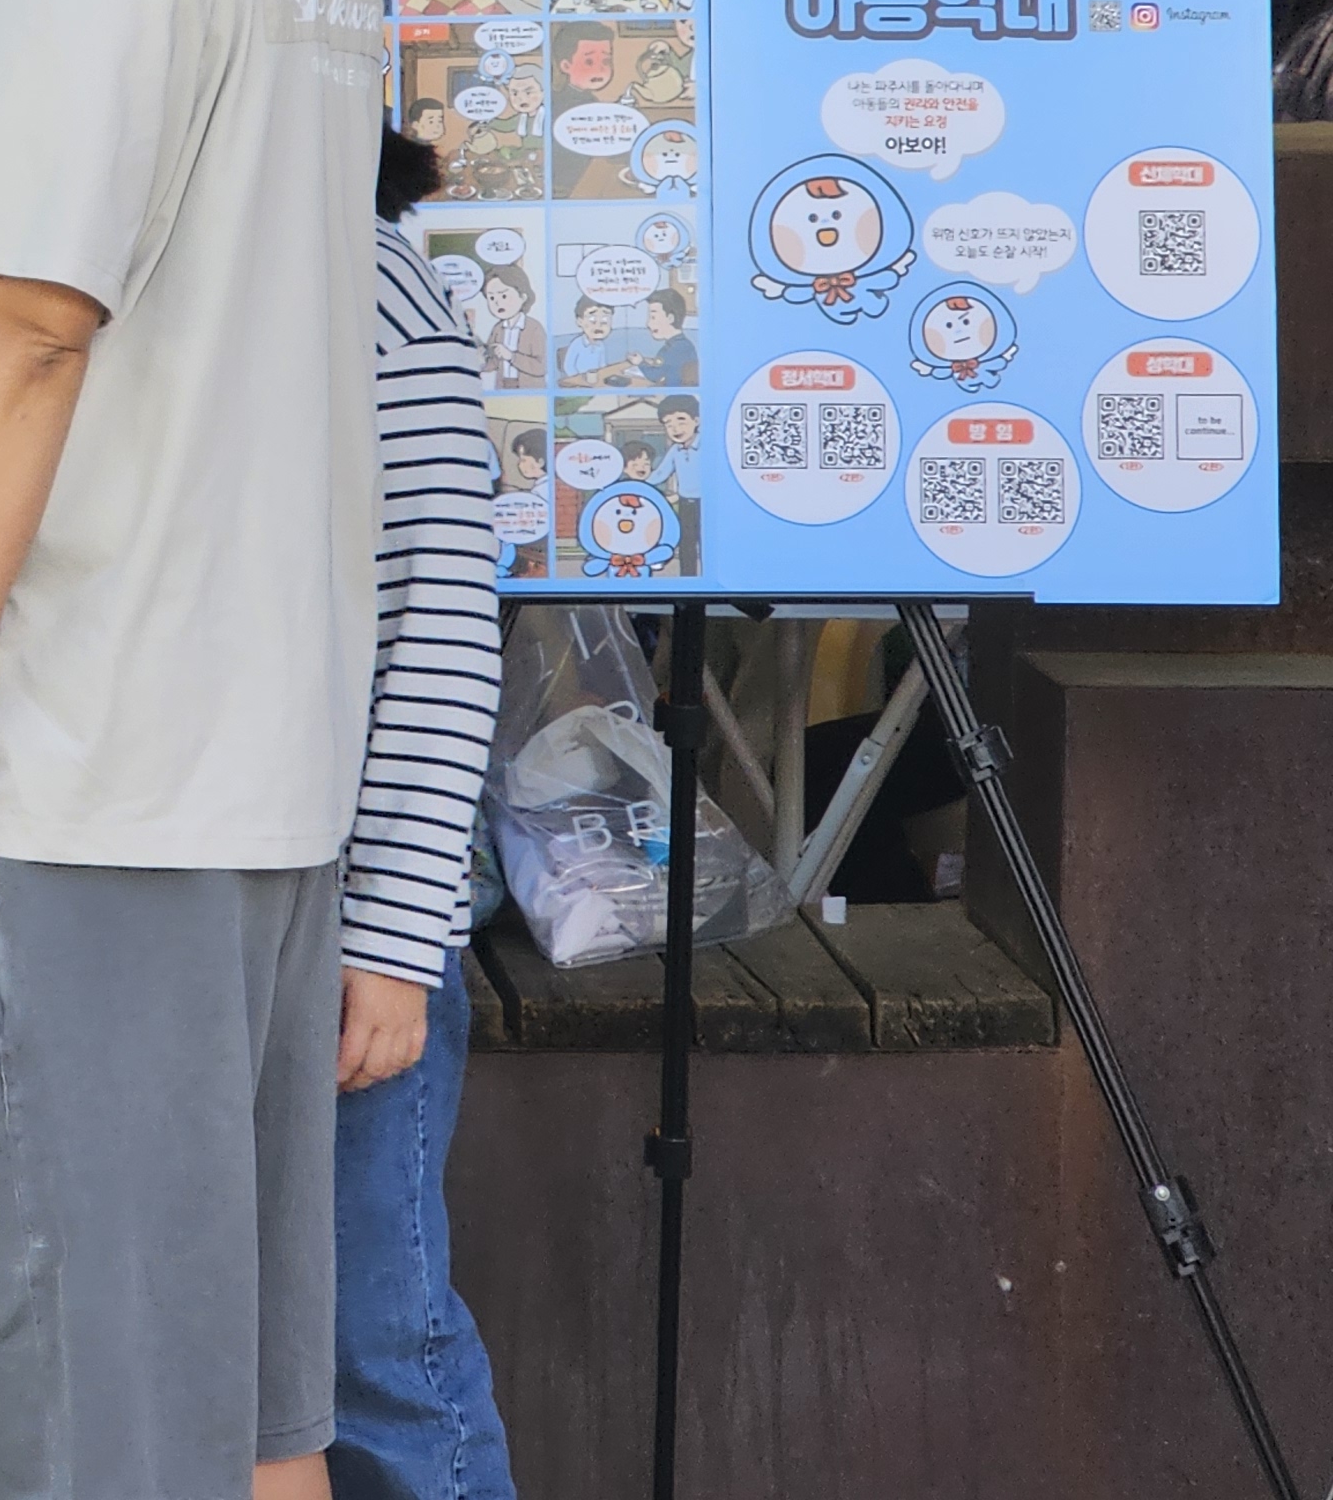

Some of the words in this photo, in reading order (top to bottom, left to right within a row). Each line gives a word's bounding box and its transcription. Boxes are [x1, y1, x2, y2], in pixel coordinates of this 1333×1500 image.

[1166, 7, 1231, 26] Instagram
[847, 81, 871, 94] 나는
[875, 80, 921, 94] 파주시를
[925, 80, 985, 94] 돌아다니며
[852, 98, 900, 112] 아동들의
[904, 98, 939, 112] 권리와
[942, 98, 979, 112] 안전을
[885, 115, 920, 129] 지키는
[923, 115, 948, 129] 요정
[885, 136, 947, 155] 아보야!
[932, 227, 955, 242] 위험
[958, 227, 993, 242] 신호가
[1023, 227, 1071, 242] 않았는지
[955, 245, 990, 259] 오늘도
[993, 245, 1017, 259] 순찰
[1020, 246, 1048, 259] 시작!
[1197, 416, 1208, 425] to
[1210, 416, 1222, 425] be
